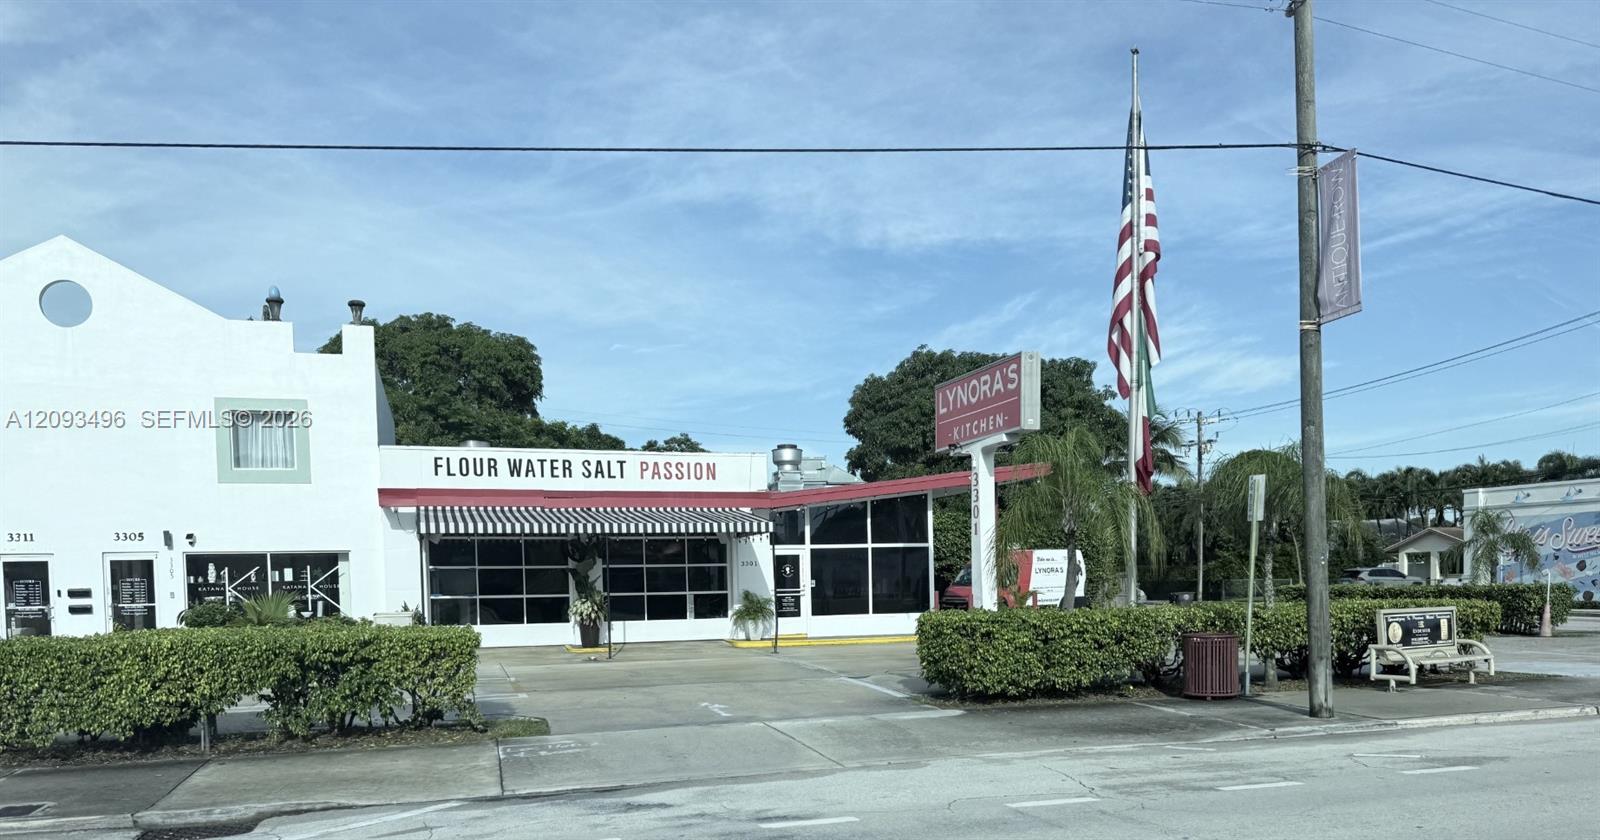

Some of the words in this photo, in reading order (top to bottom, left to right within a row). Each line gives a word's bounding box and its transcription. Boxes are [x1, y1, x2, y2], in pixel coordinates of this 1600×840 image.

[1331, 168, 1345, 216] ROW
[1331, 219, 1348, 308] ANTIQUE
[939, 363, 1019, 415] LYNORA'S
[433, 456, 498, 478] FLOUR
[507, 458, 573, 479] WATER
[581, 459, 627, 480] SALT
[640, 460, 717, 481] PASSION
[972, 471, 980, 536] 3301
[7, 532, 35, 543] 3311
[113, 532, 145, 542] 3305
